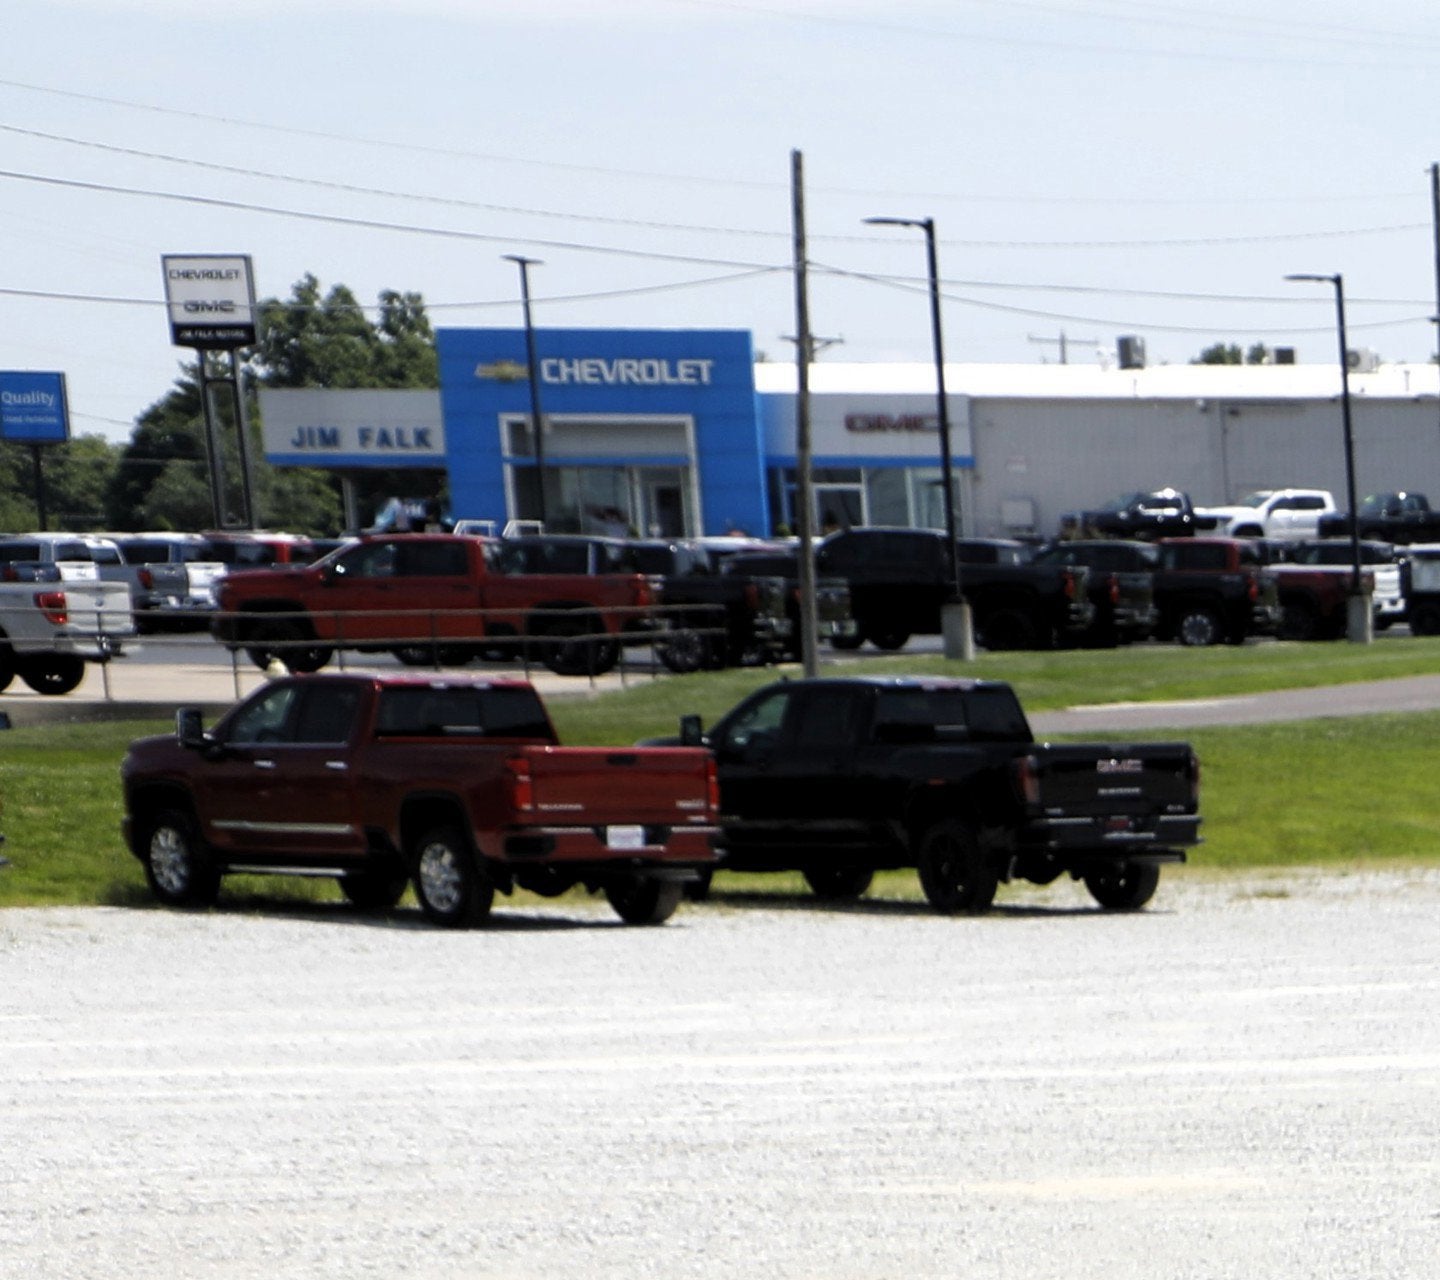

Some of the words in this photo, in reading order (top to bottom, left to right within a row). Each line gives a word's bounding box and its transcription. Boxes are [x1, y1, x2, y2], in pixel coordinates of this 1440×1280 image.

[168, 269, 240, 280] CHEVROLET
[184, 300, 235, 312] GMC
[540, 358, 713, 385] CHEVROLET
[1, 390, 54, 407] Quality
[844, 413, 940, 433] GMC
[291, 426, 340, 448] JIM
[358, 426, 432, 448] FALK
